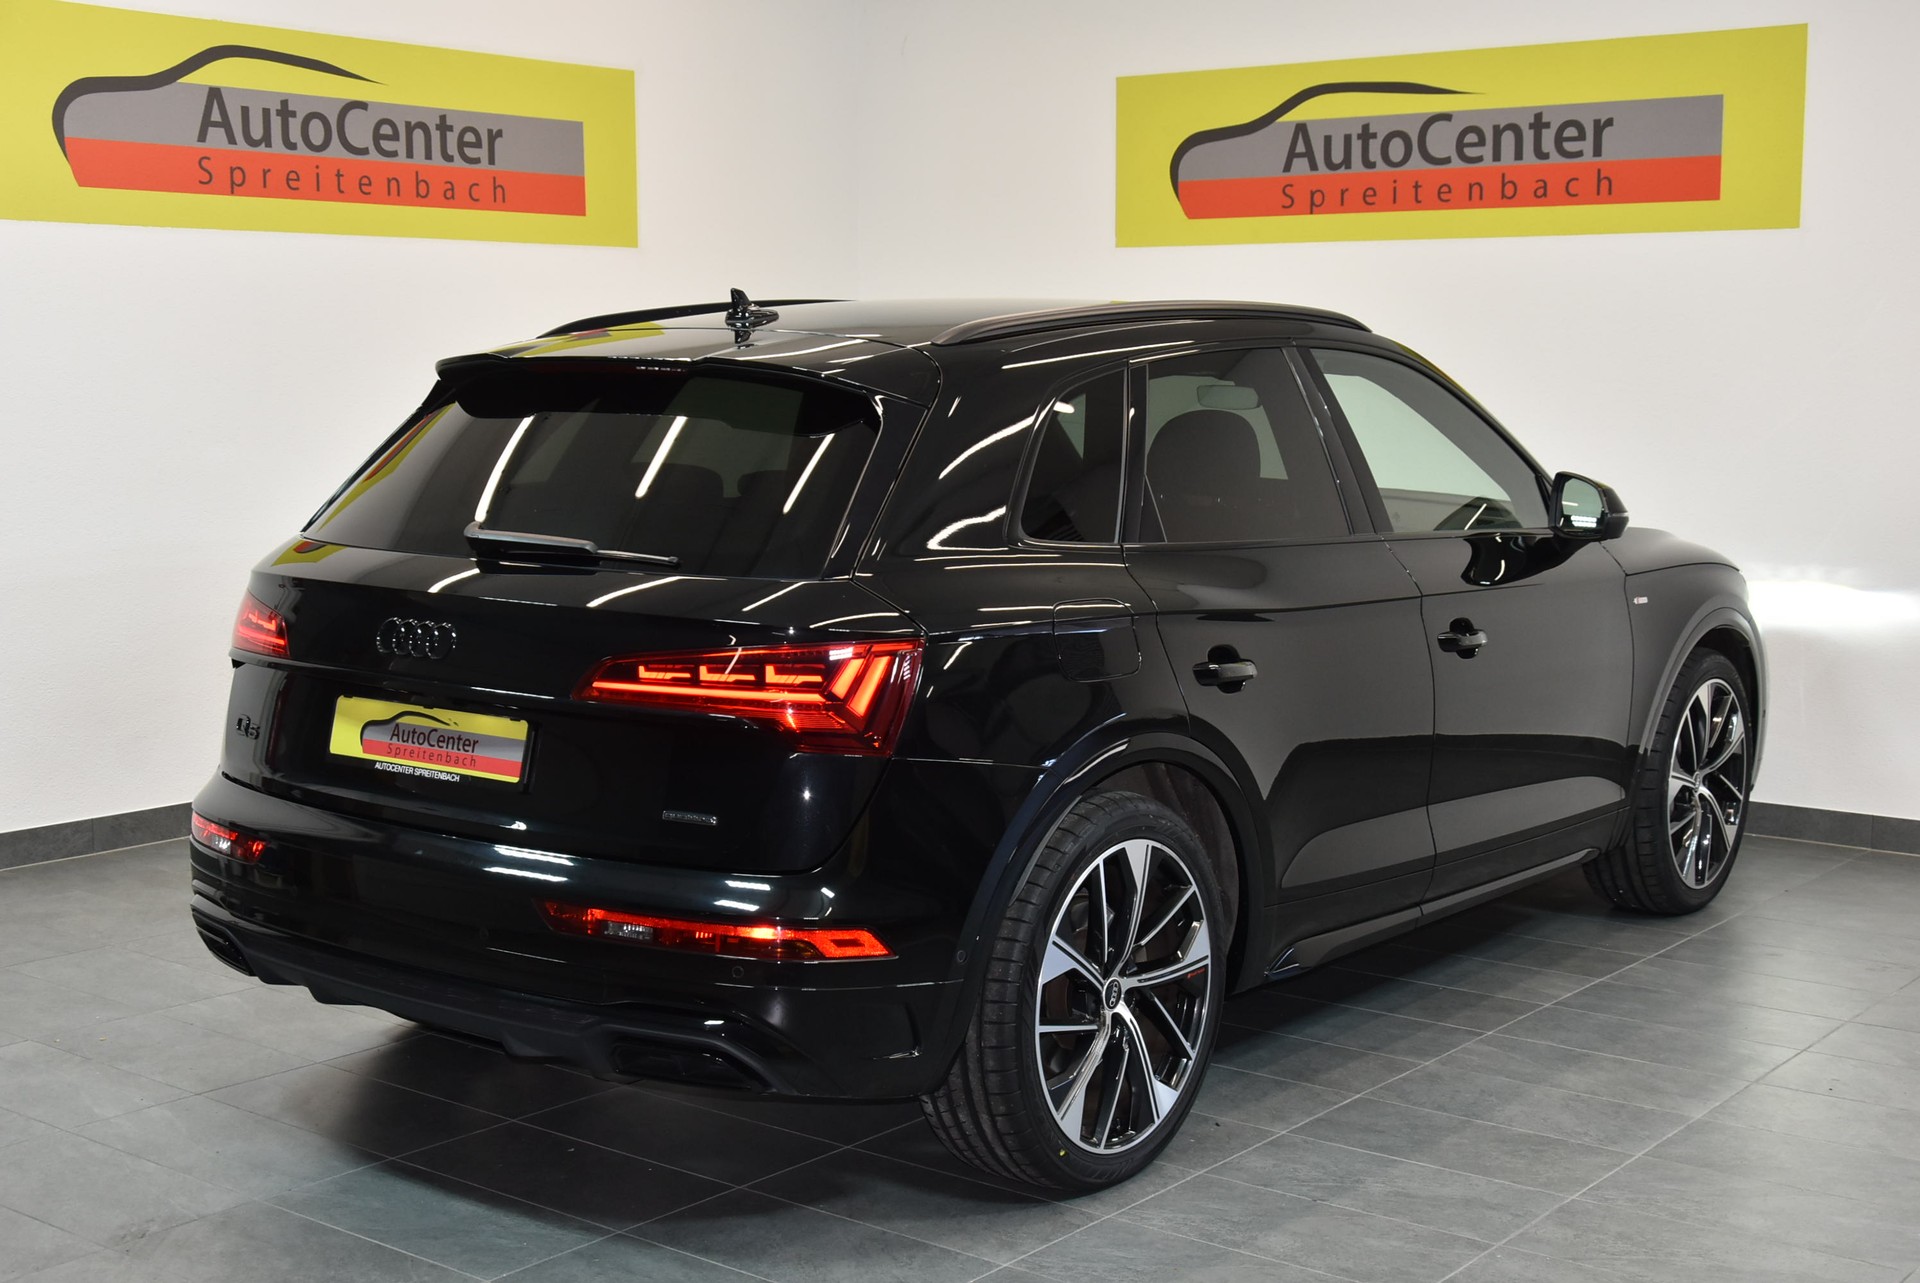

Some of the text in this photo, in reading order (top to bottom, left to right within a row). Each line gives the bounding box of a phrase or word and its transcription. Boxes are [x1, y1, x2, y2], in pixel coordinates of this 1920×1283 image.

[197, 87, 504, 166] AutoCenter
[1282, 111, 1614, 173] AutoCenter
[198, 156, 506, 204] Spreitenbach
[1281, 169, 1614, 215] Spreitenbach
[387, 742, 477, 768] Spreitenbach
[389, 723, 479, 754] AutoCenter
[374, 761, 460, 782] AUTOCENTER SPREITENBACH
